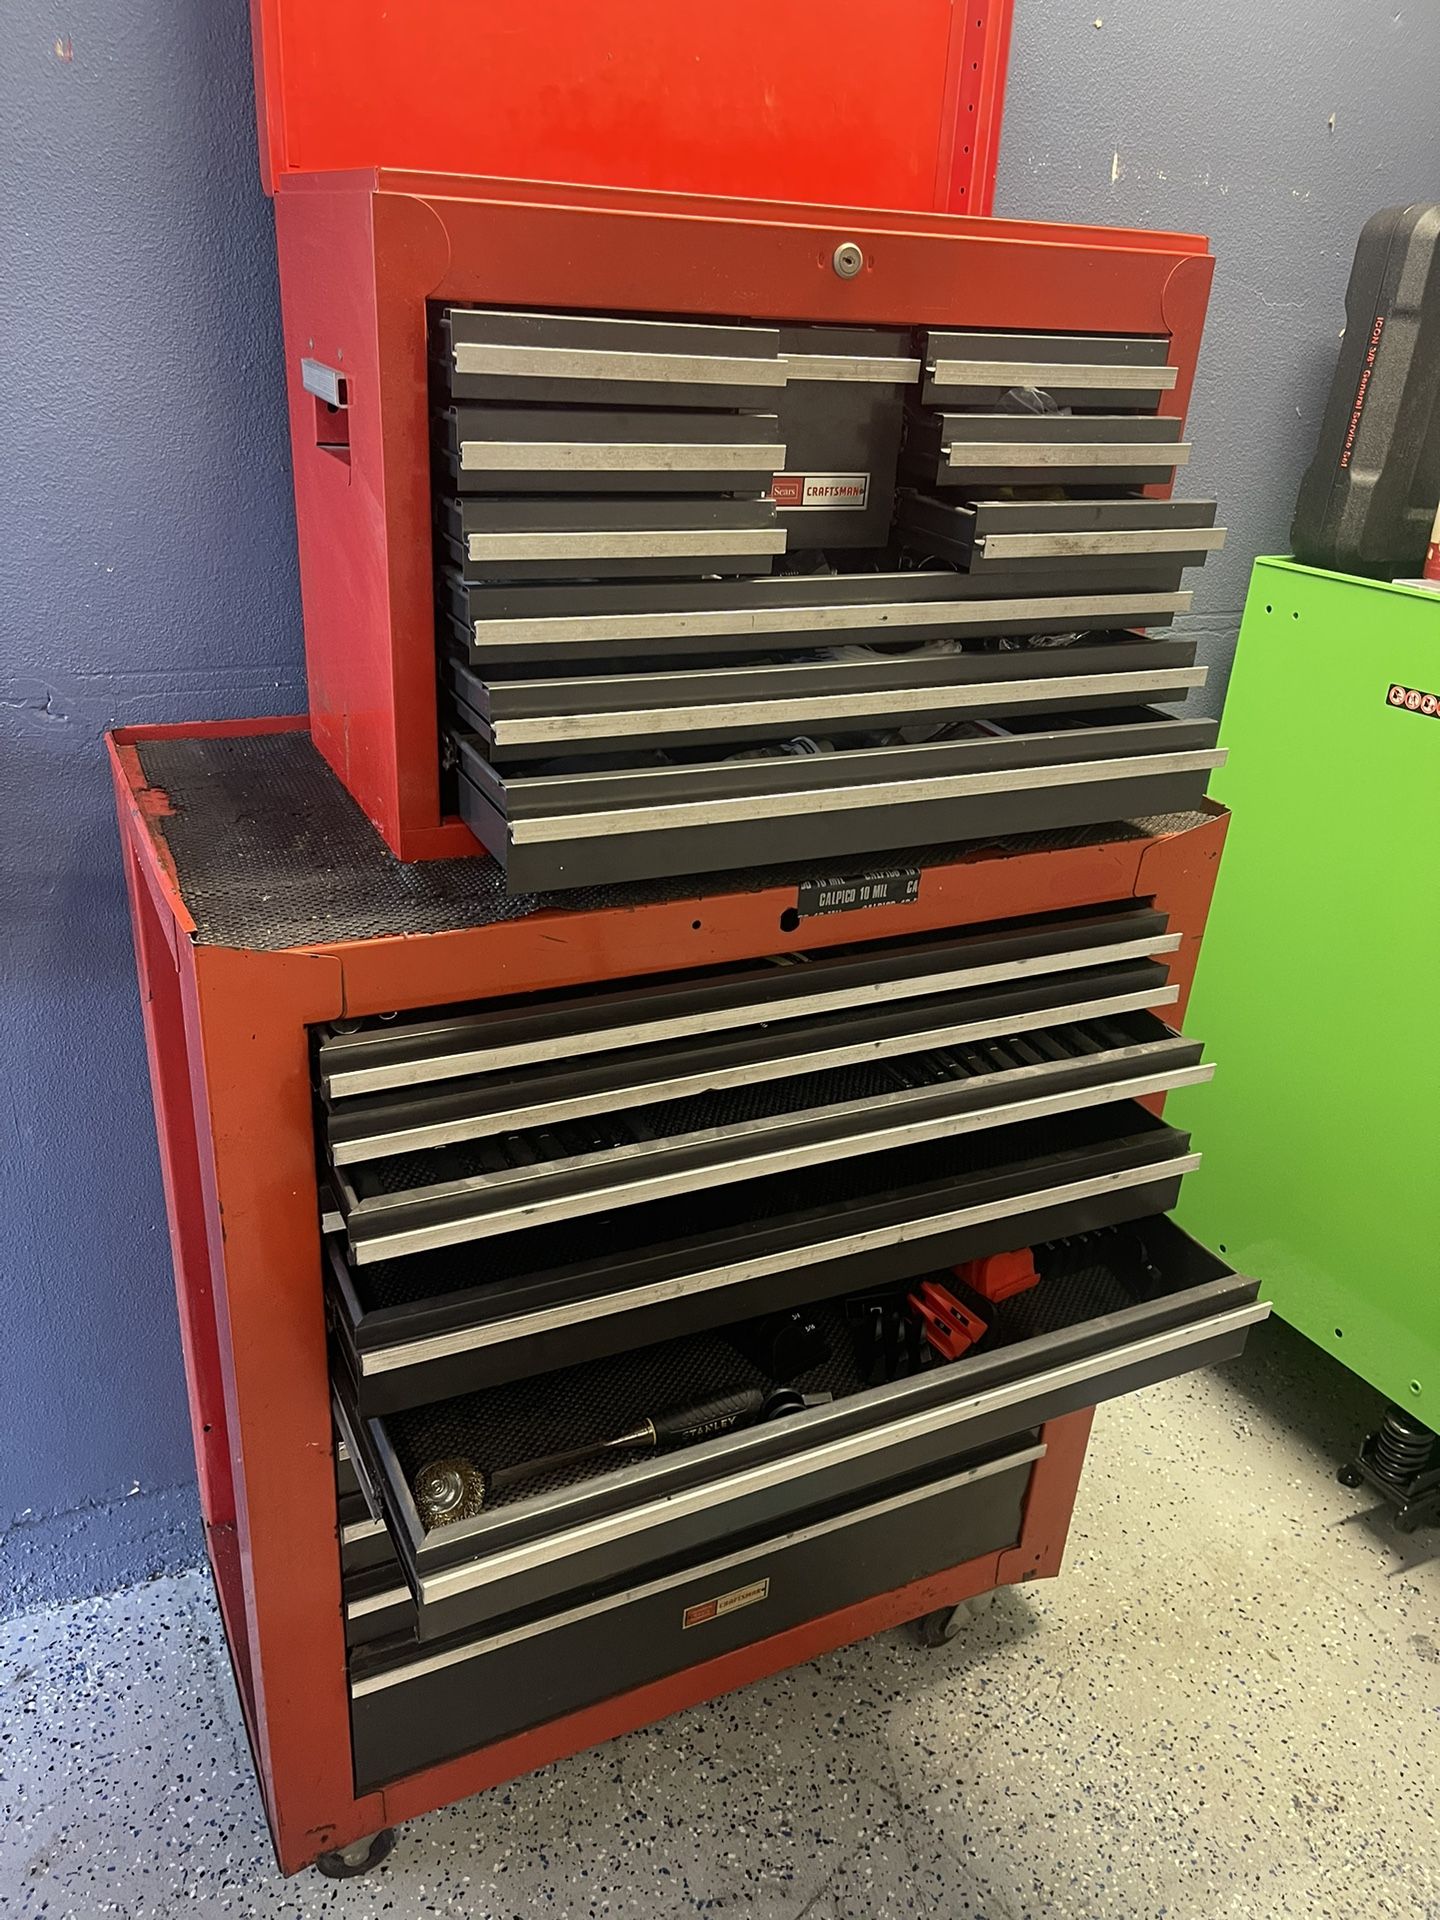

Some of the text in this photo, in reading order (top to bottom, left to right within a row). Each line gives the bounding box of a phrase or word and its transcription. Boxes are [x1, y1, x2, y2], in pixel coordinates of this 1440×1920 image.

[1341, 317, 1384, 467] ICON 3/8" General Service Set
[774, 486, 859, 497] Sears CRAFTSMAN
[819, 888, 856, 907] CALPICO
[860, 886, 870, 900] 10
[872, 883, 888, 899] MIL
[682, 1416, 737, 1439] STANLEY
